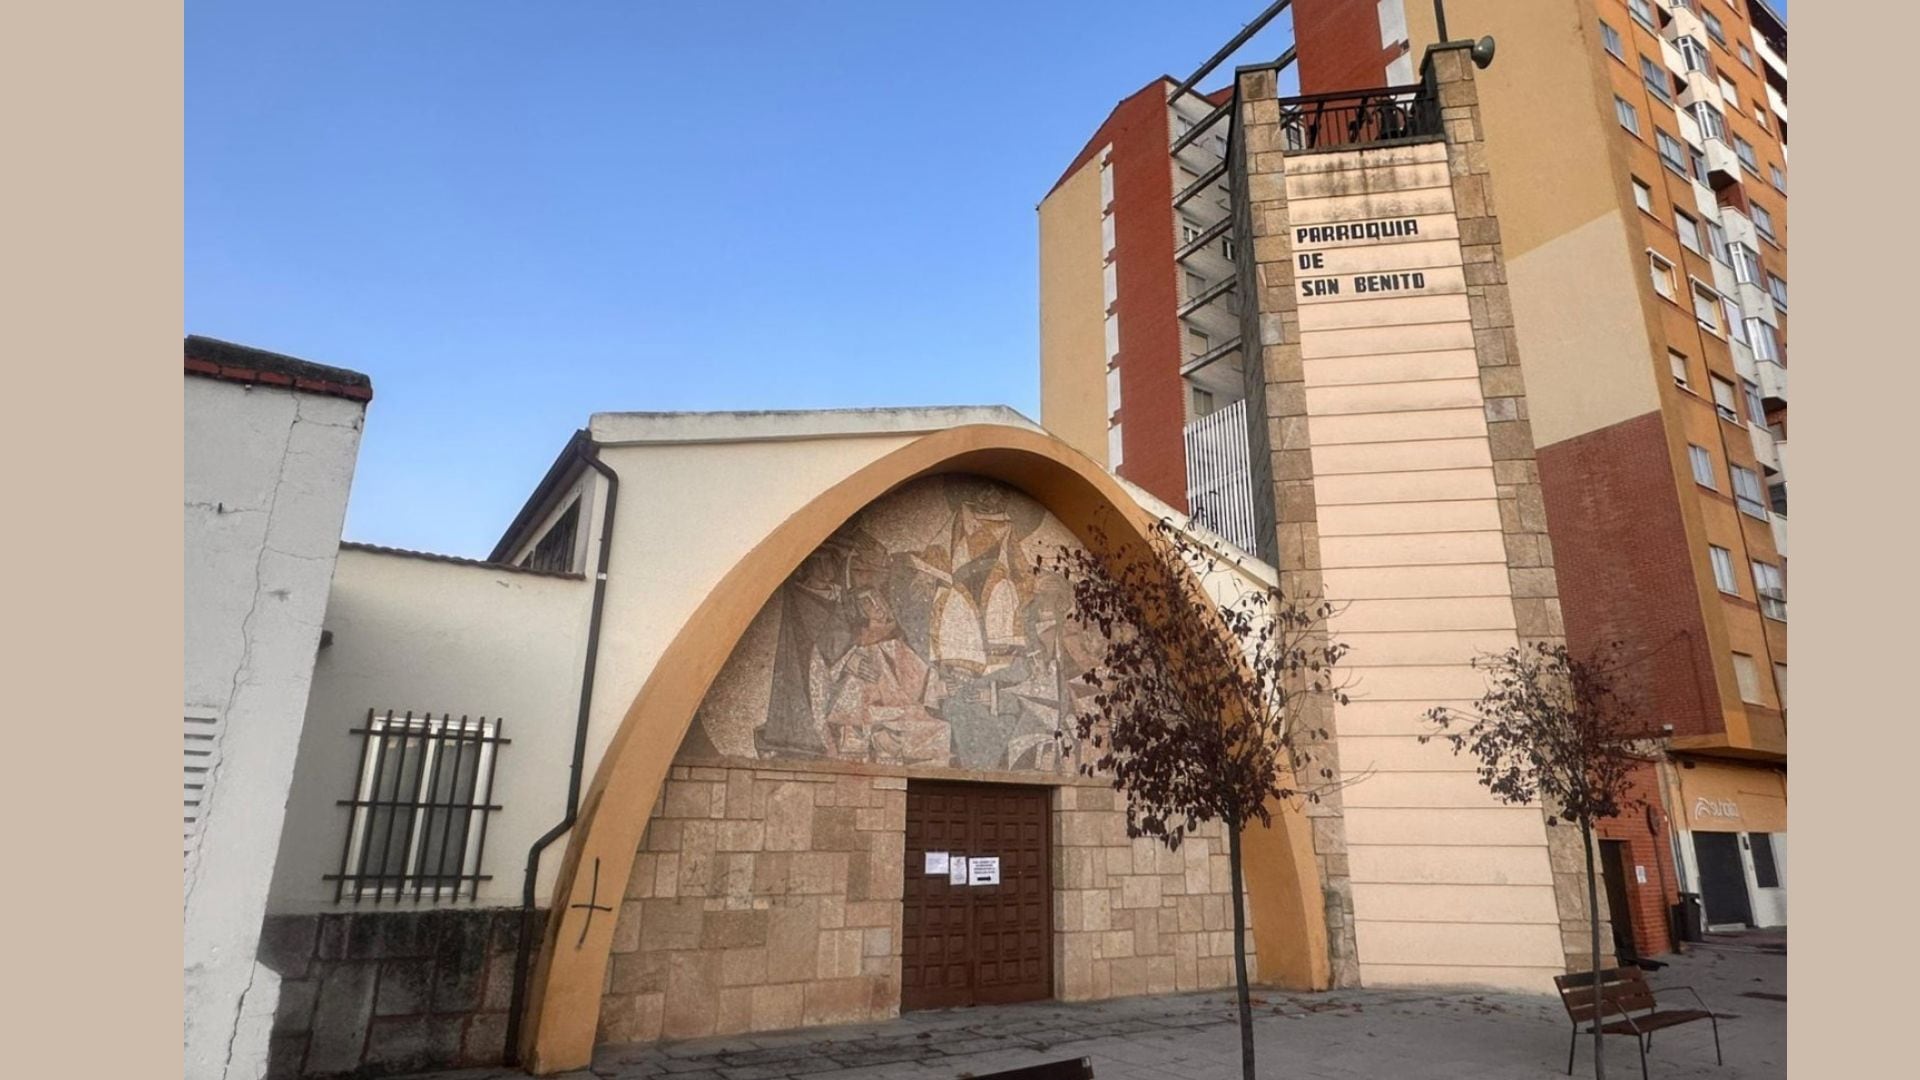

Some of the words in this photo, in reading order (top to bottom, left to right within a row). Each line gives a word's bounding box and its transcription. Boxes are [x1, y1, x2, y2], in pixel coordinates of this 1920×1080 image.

[1296, 219, 1419, 244] PARROQUIA
[1298, 252, 1325, 270] DE
[1301, 278, 1340, 298] SAN
[1354, 272, 1425, 294] BENITO
